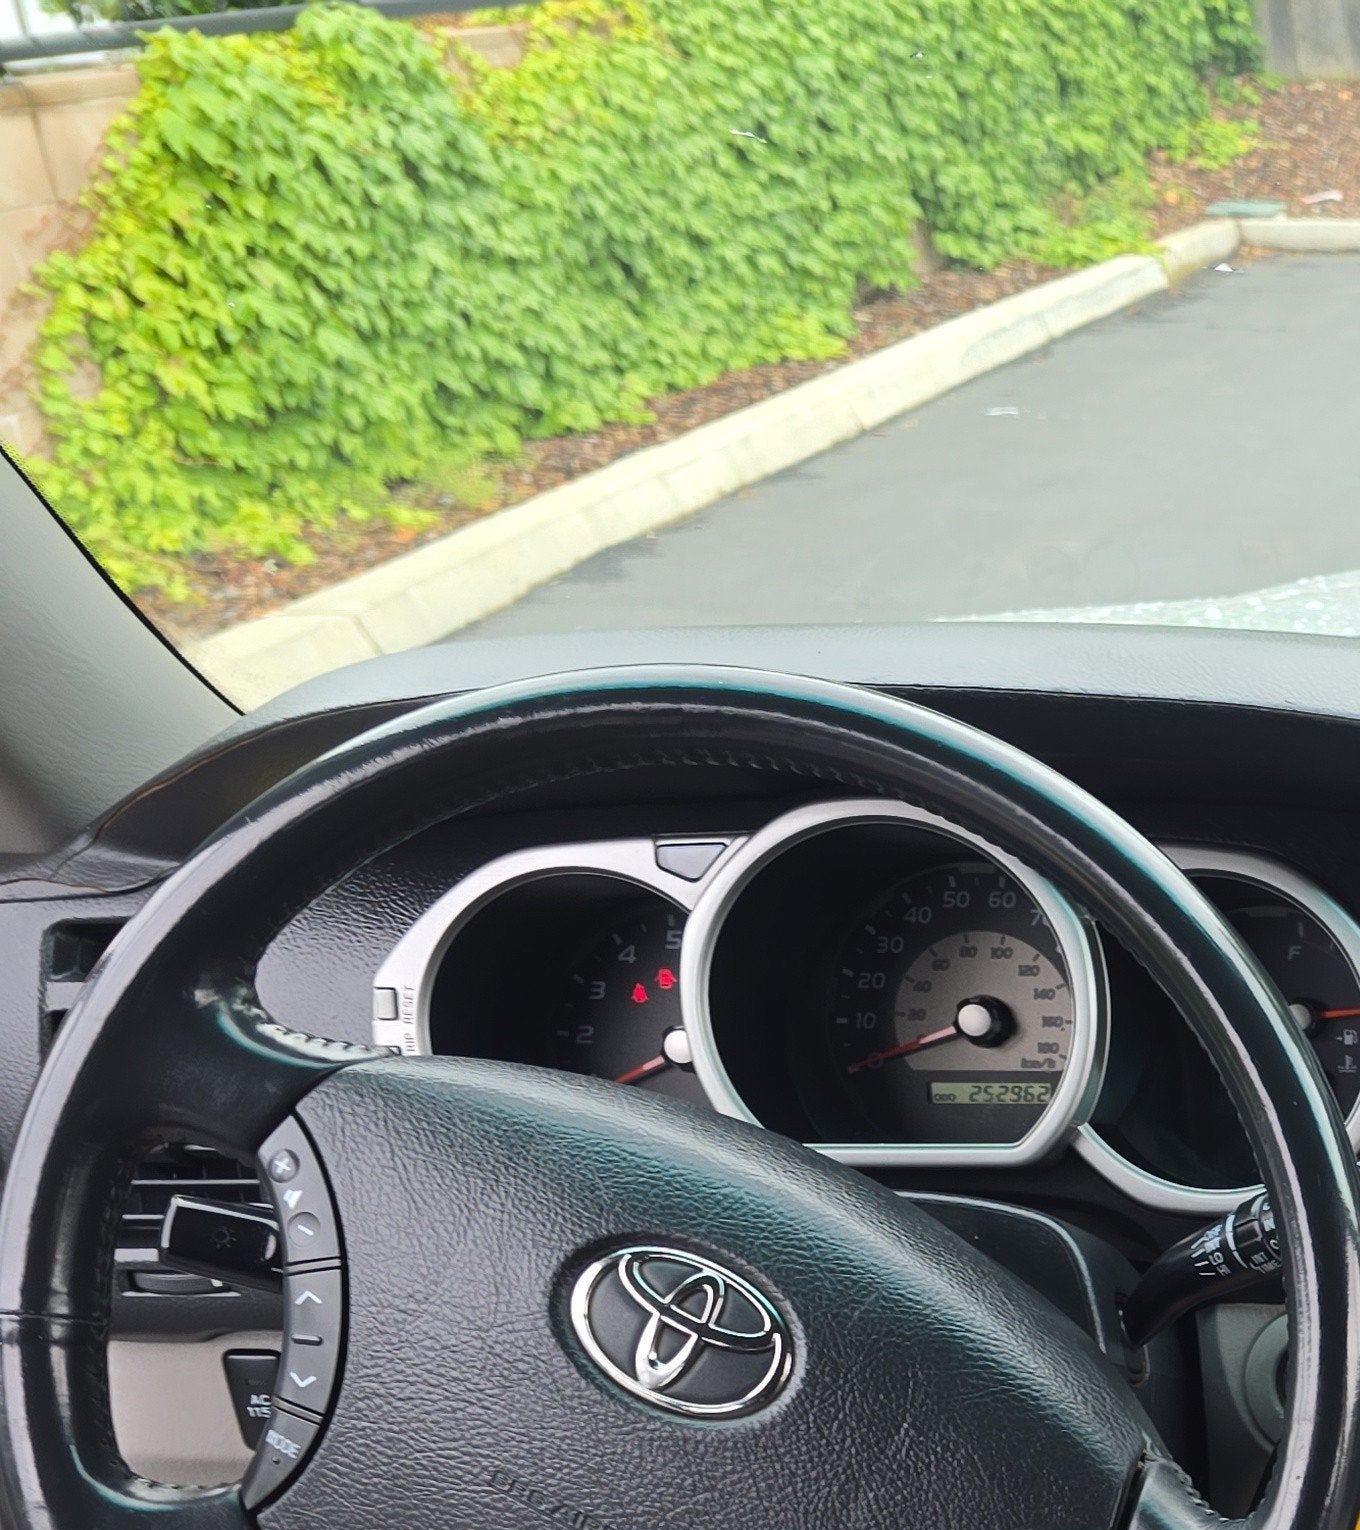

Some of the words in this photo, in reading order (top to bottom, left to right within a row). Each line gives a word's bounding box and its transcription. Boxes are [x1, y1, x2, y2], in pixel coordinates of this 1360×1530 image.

[943, 892, 970, 908] 50
[988, 892, 1016, 908] 60
[904, 907, 932, 923] 40
[666, 931, 682, 949] 5
[877, 937, 903, 953] 30
[618, 945, 636, 964] 4
[991, 946, 1013, 959] 100
[1287, 946, 1301, 960] F
[1018, 964, 1040, 977] 120
[858, 973, 885, 989] 20
[589, 981, 607, 1000] 3
[855, 1013, 877, 1029] 10
[576, 1025, 595, 1045] 2
[969, 1085, 1050, 1102] 252962
